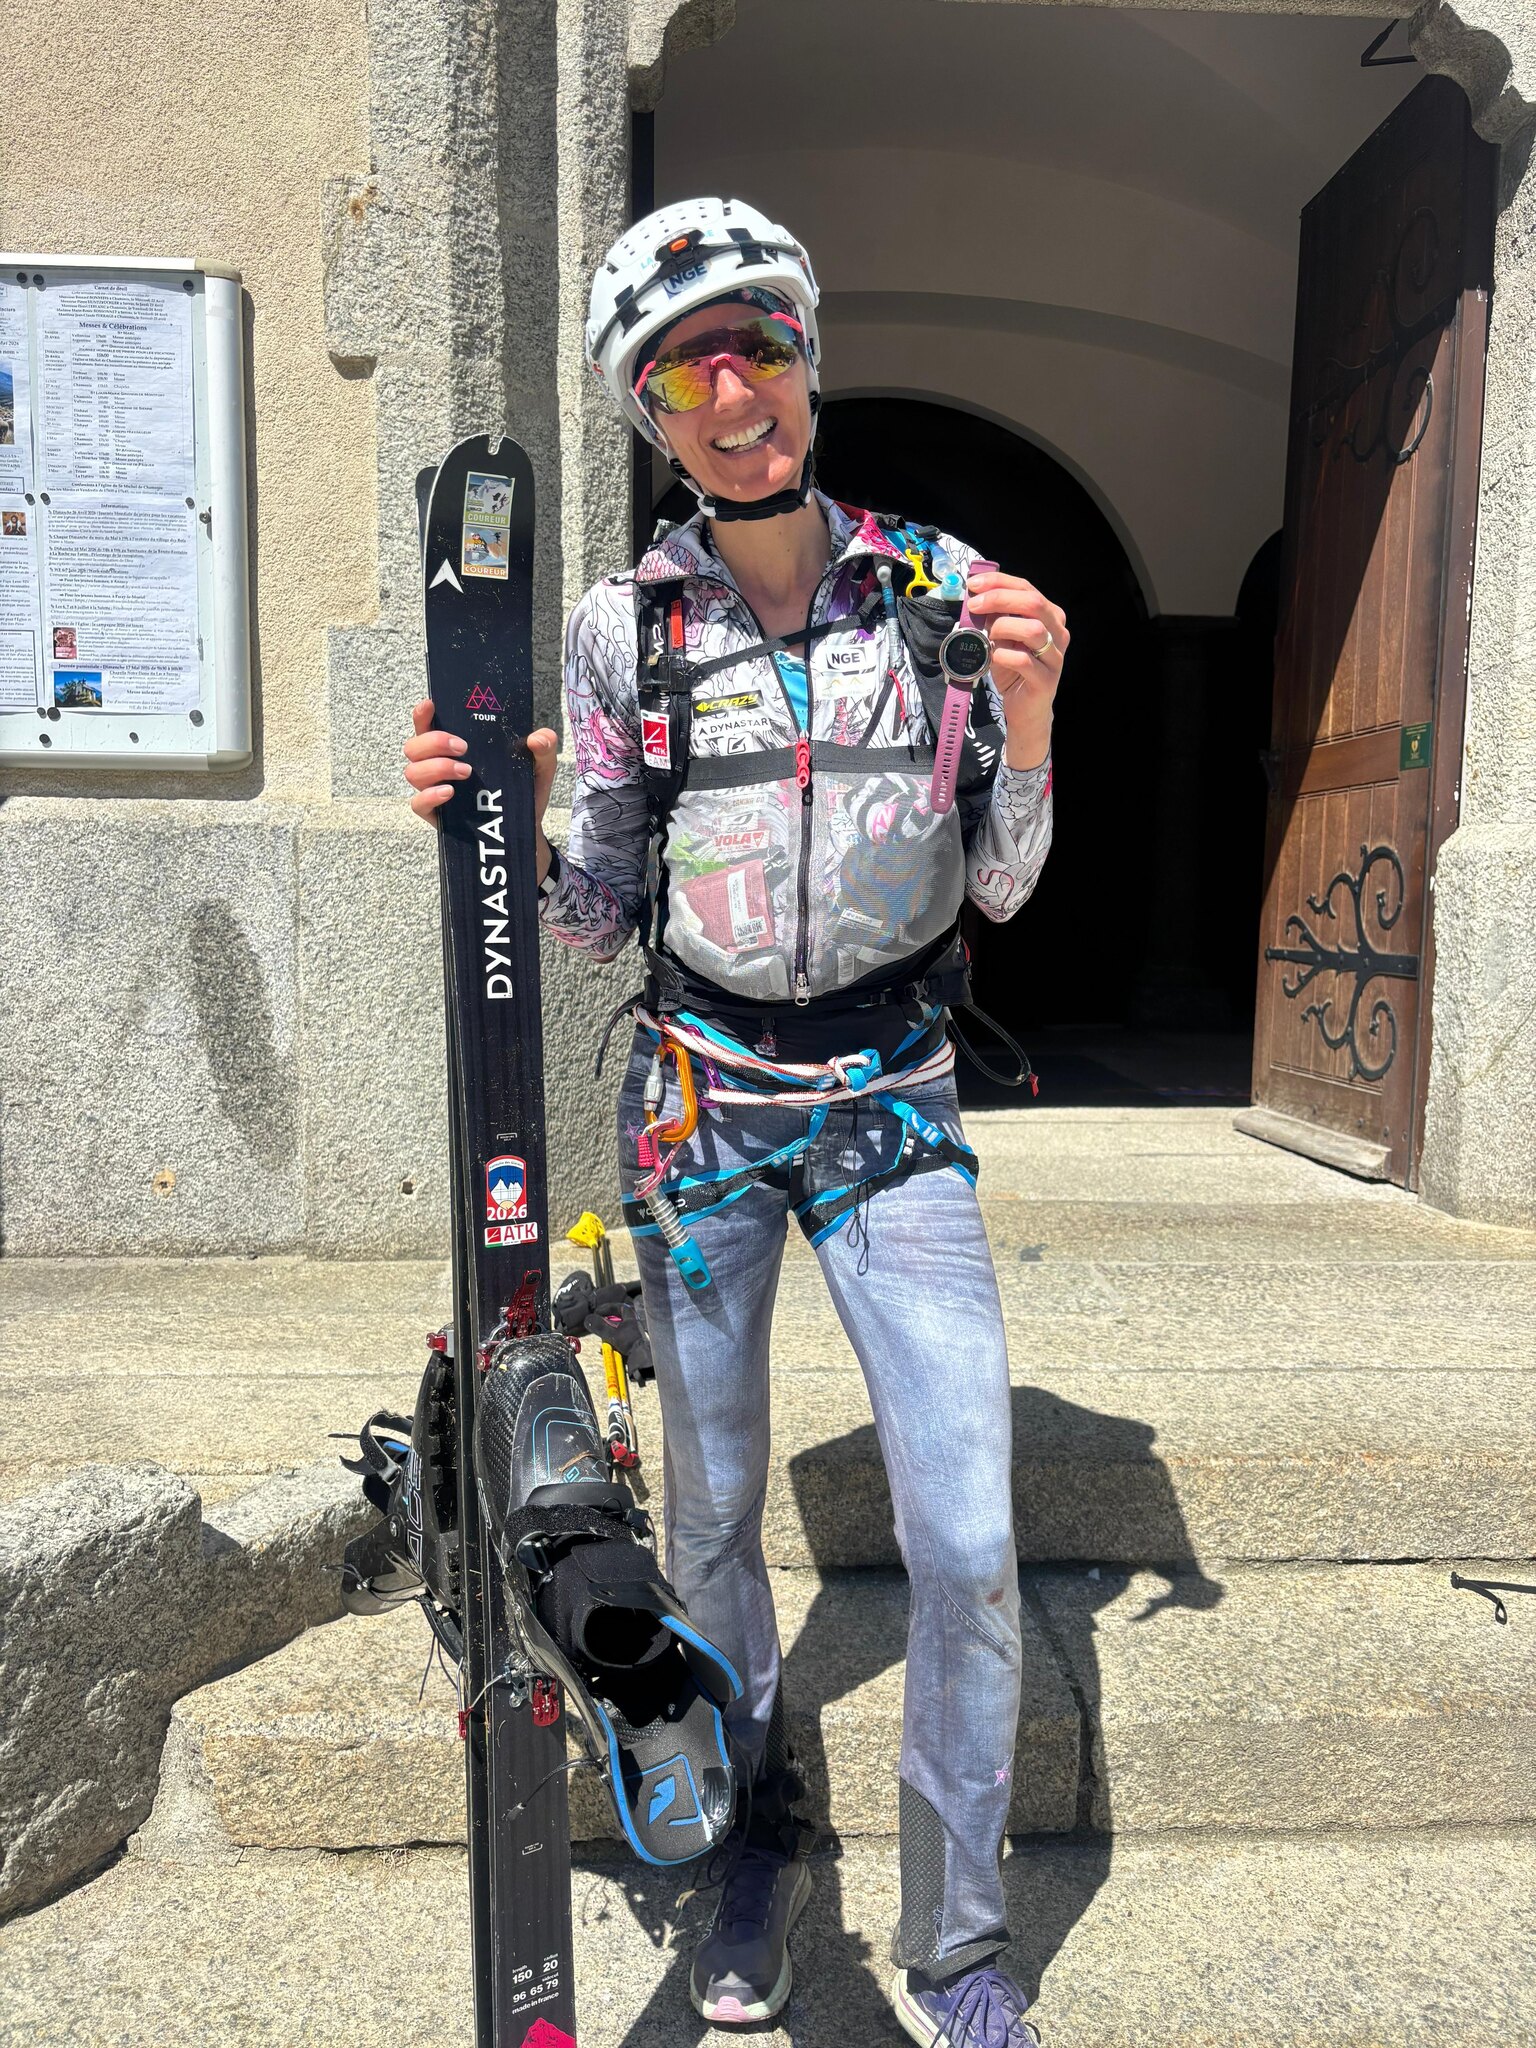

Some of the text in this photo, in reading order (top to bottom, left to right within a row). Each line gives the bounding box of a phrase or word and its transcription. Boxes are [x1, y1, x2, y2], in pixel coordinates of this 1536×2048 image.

[669, 264, 708, 289] NGE
[109, 322, 147, 331] Célébrations
[468, 513, 506, 524] COUREUR
[465, 566, 506, 576] COUREUR
[832, 652, 860, 664] NGE
[709, 694, 759, 710] CRAZY
[473, 713, 496, 722] TOUR
[710, 718, 768, 733] DYNASTAR
[652, 746, 666, 755] ATK
[714, 833, 751, 847] VOLA
[476, 789, 513, 1000] DYNASTAR
[487, 1204, 527, 1221] 2026
[504, 1223, 536, 1241] ATK
[512, 1960, 558, 1984] 150 20
[513, 1978, 559, 2003] 96 65 79
[512, 2003, 531, 2014] made
[538, 1992, 560, 2003] france
